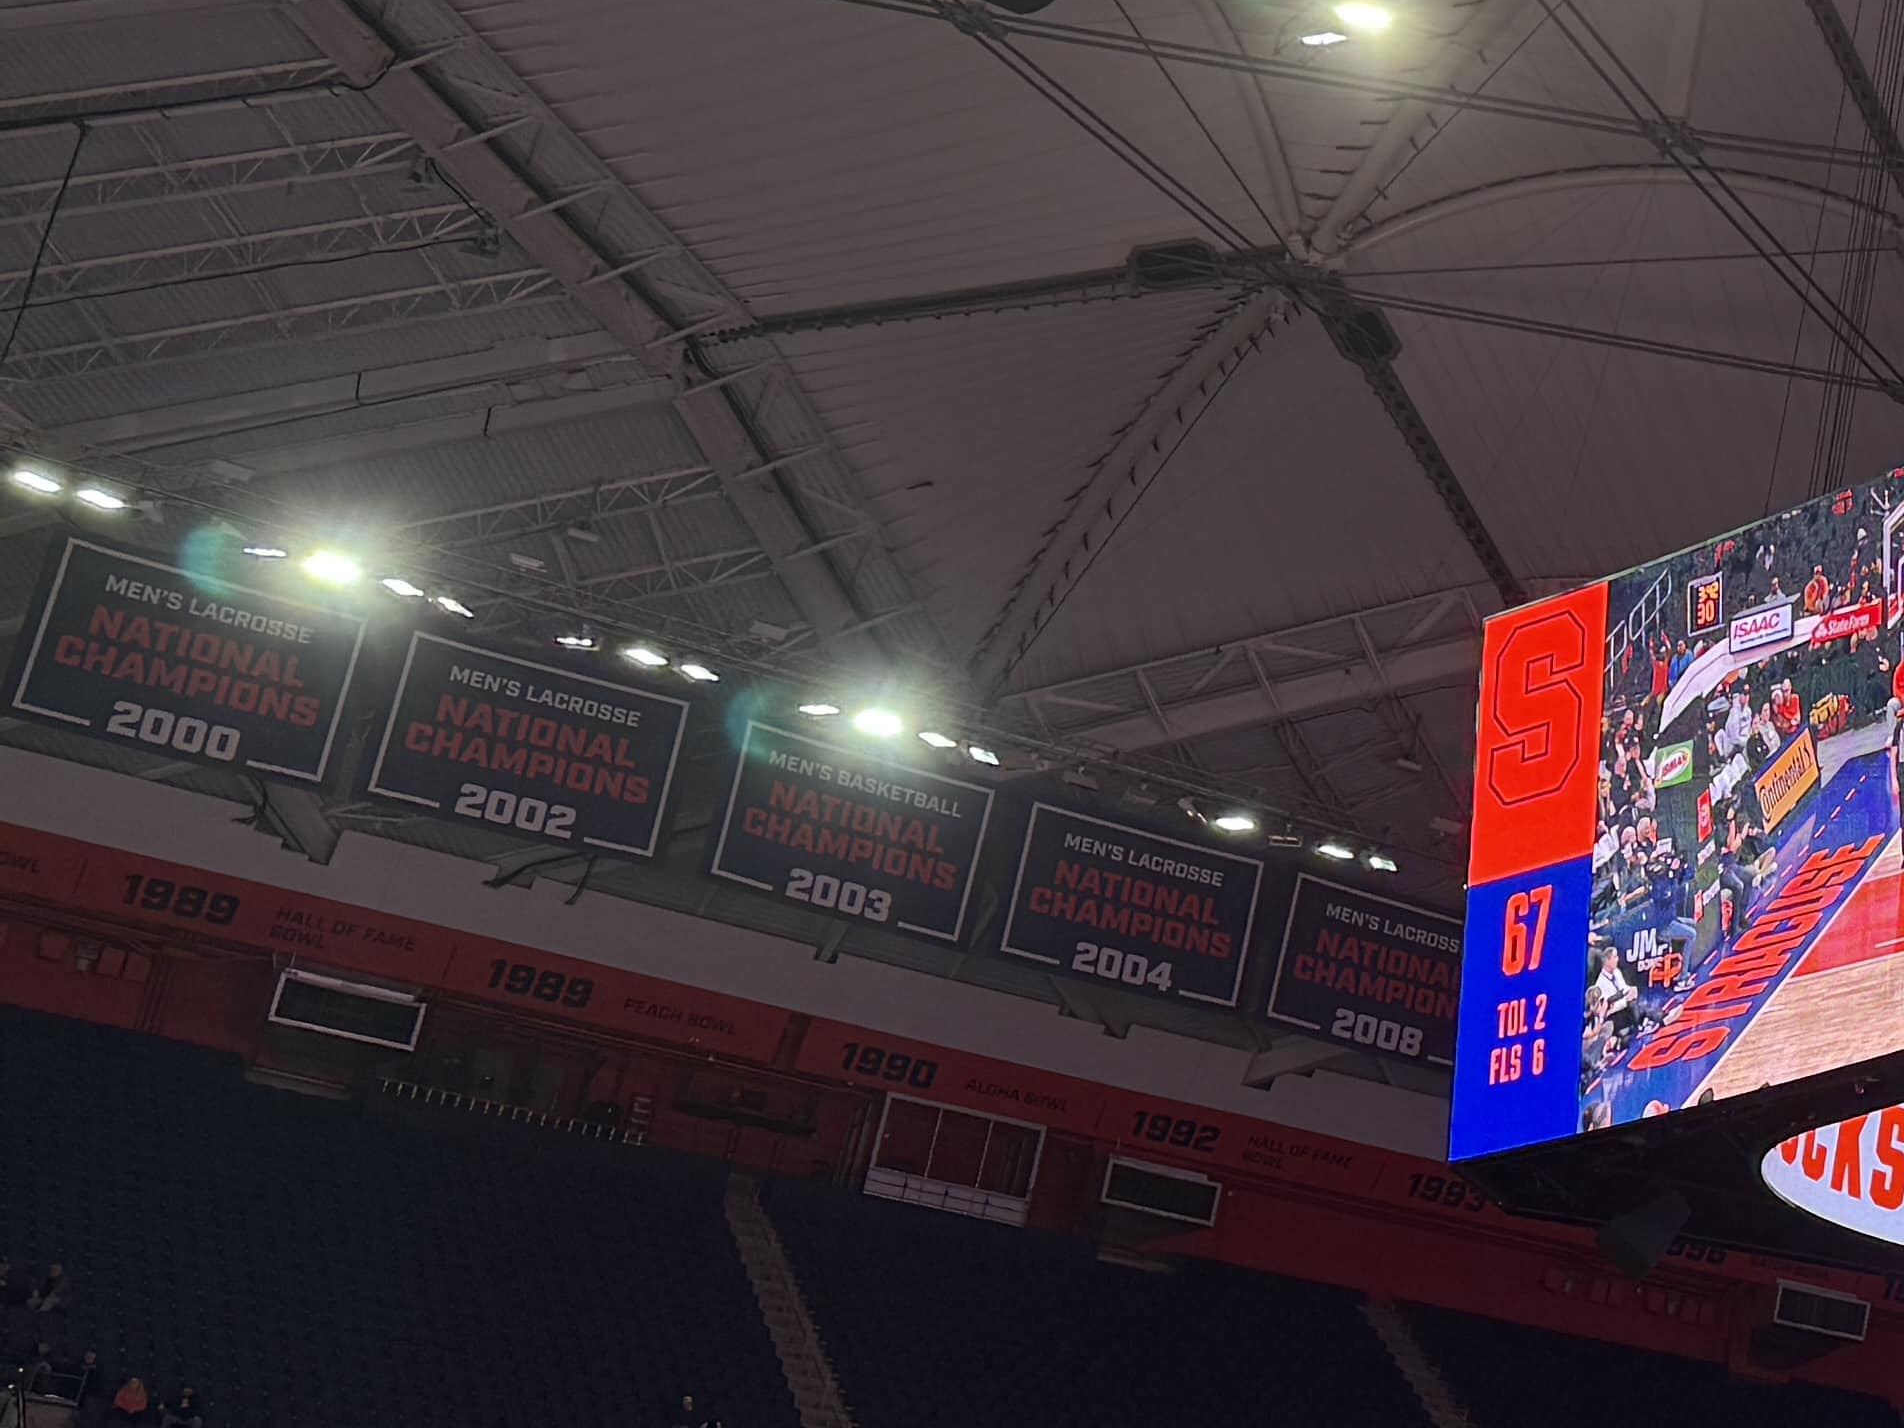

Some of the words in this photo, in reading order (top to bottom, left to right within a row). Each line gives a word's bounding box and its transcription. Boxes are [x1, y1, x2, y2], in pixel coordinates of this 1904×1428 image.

[187, 591, 312, 645] LACROSSE
[1733, 613, 1781, 640] ISAAC
[89, 604, 304, 689] NATIONAL
[54, 636, 321, 727] CHAMPIONS
[526, 684, 642, 728] LACROSSE
[106, 700, 241, 761] 2000
[436, 693, 636, 769] NATIONAL
[406, 722, 650, 804] CHAMPIONS
[454, 783, 576, 839] 2002
[770, 781, 944, 855] NATIONAL
[837, 766, 963, 819] BASKETBALL
[742, 808, 958, 891] CHAMPIONS
[1127, 847, 1224, 888] LACROSSE
[122, 875, 239, 926] 1989
[786, 869, 891, 922] 2003
[1054, 859, 1220, 925] NATIONAL
[1029, 888, 1233, 960] CHAMPIONS
[1384, 919, 1461, 953] LACROSS
[1502, 884, 1552, 977] 67
[1072, 942, 1173, 992] 2004
[1627, 833, 1885, 1070] SYRACUSE
[489, 959, 593, 1008] 1989
[1292, 958, 1460, 1019] CHAMPION
[1331, 1008, 1424, 1057] 2008
[1497, 999, 1528, 1035] TOL
[1534, 995, 1546, 1030] 2
[839, 1043, 938, 1090] 1990
[1489, 1047, 1522, 1086] FLS
[1531, 1044, 1544, 1077] 6
[1130, 1110, 1221, 1154] 1992
